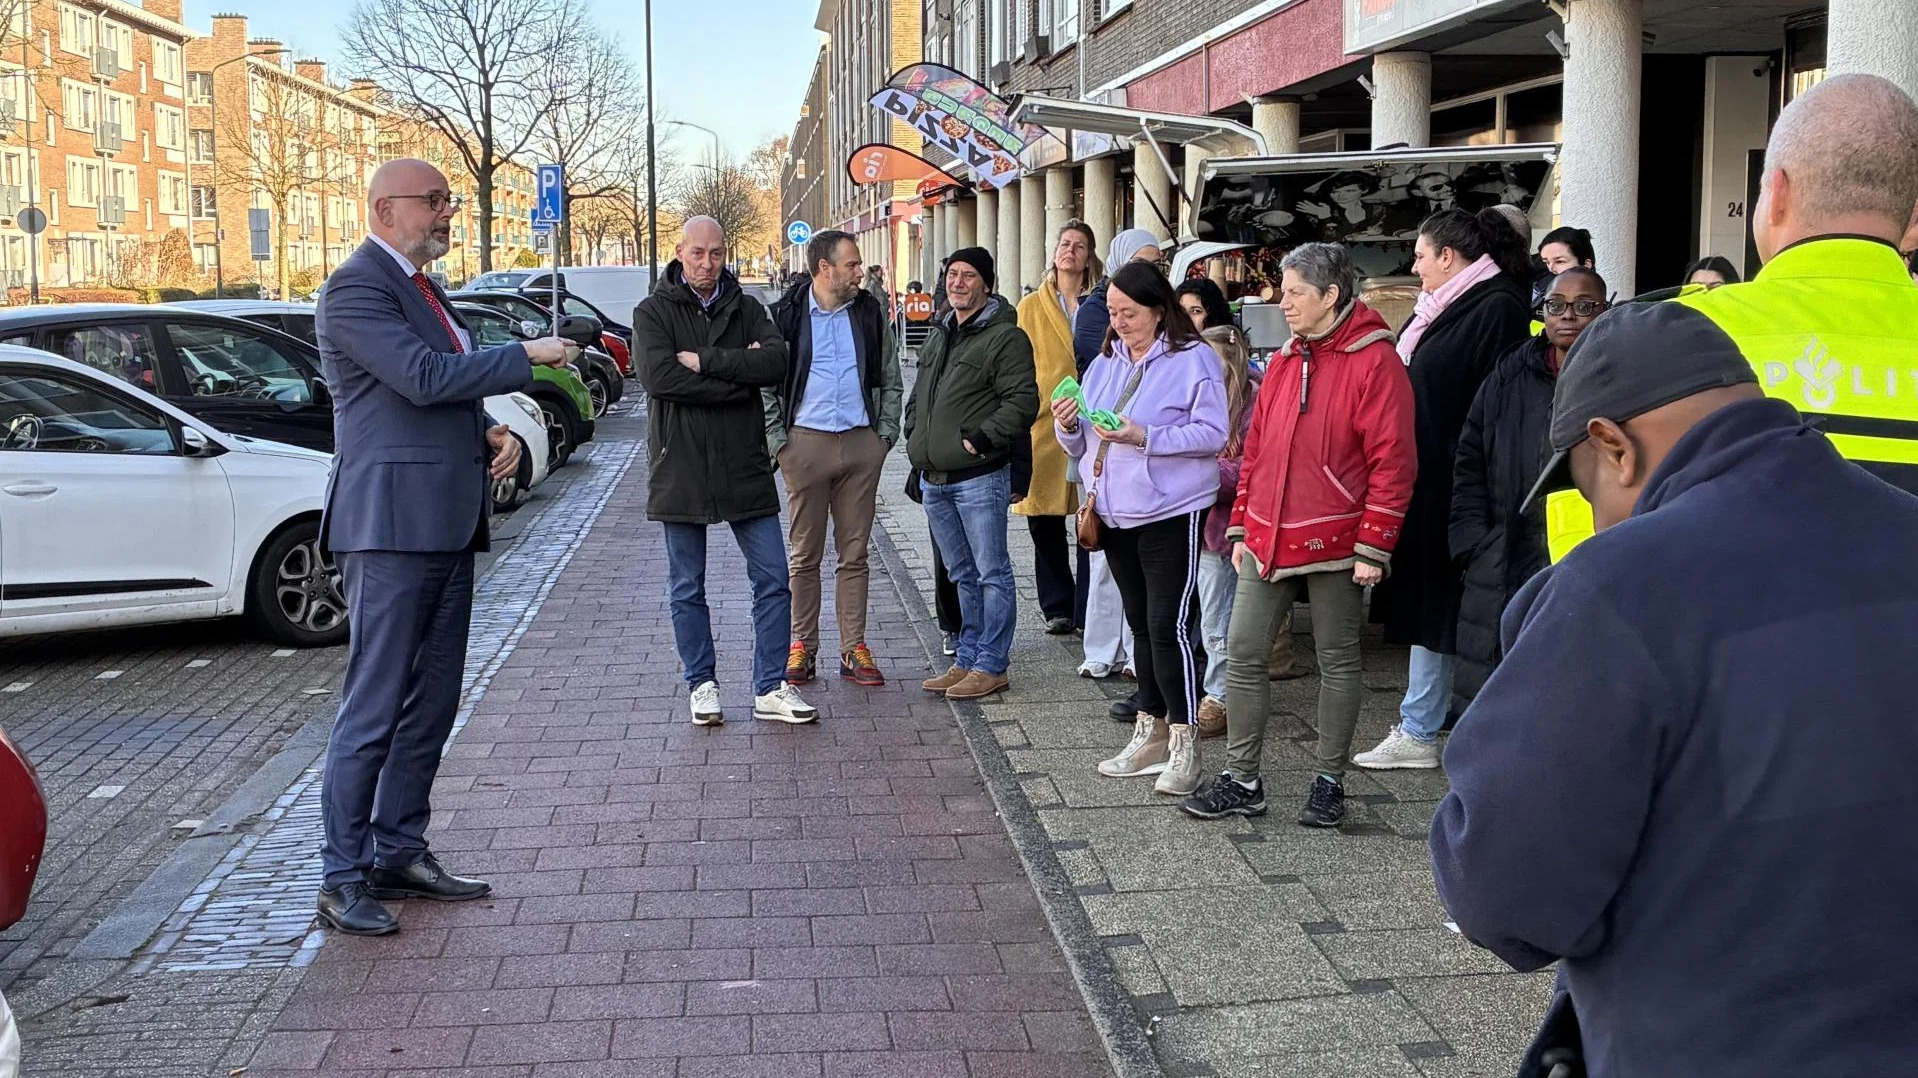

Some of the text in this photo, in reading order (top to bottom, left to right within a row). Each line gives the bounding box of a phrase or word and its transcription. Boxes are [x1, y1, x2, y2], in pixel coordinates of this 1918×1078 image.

[542, 169, 556, 198] P
[1728, 201, 1743, 217] 24
[906, 296, 930, 313] ria
